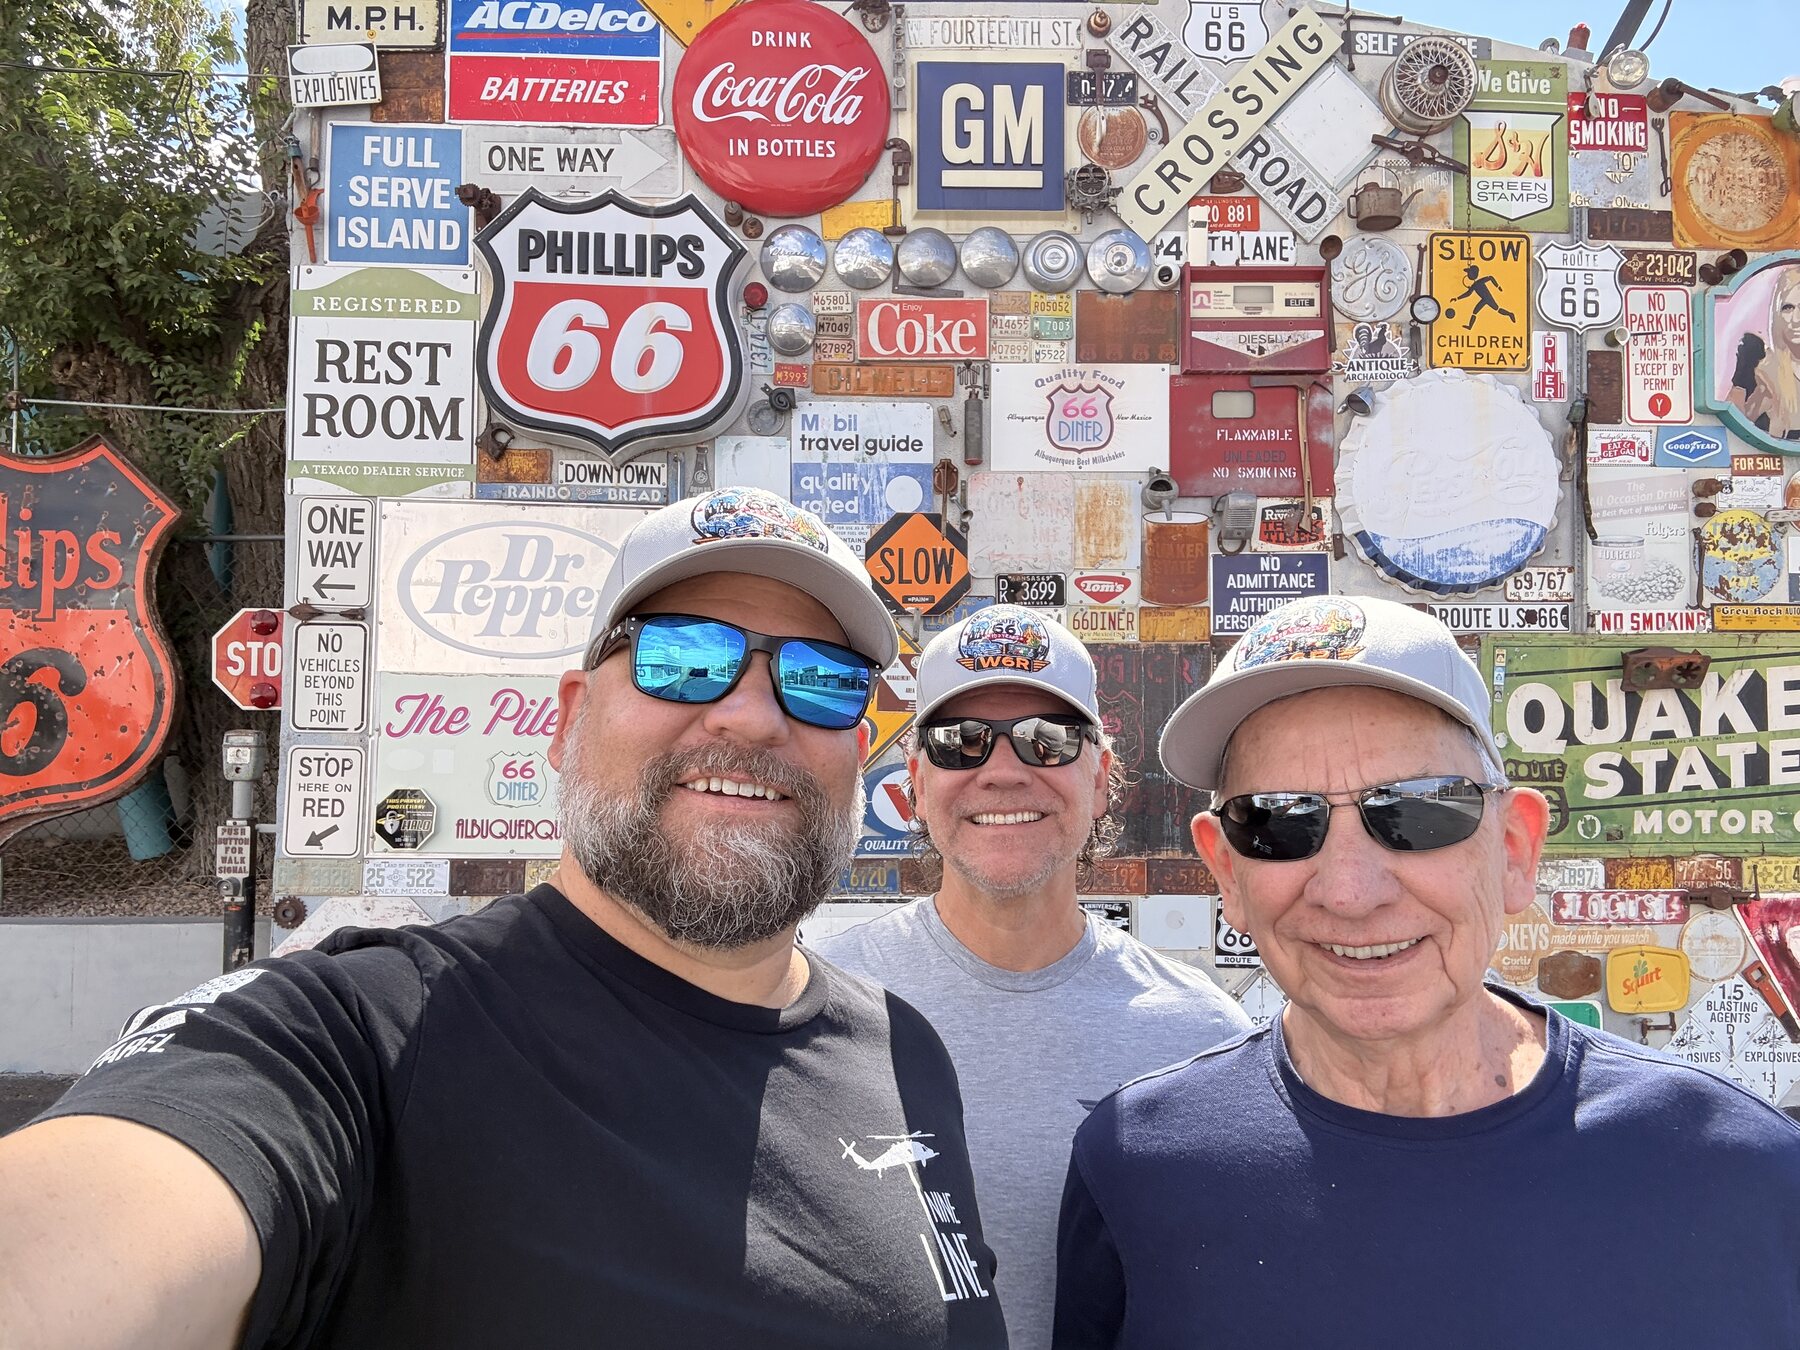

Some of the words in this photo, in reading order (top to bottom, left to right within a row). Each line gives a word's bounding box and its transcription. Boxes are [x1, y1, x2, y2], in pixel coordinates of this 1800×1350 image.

[328, 6, 424, 31] M.P.H.
[464, 1, 659, 33] ACDelco
[752, 31, 812, 48] DRINK
[933, 19, 1041, 47] FOURTEENTH
[1052, 20, 1076, 47] ST.
[1205, 21, 1245, 51] 66
[1355, 32, 1398, 55] SELF
[1120, 15, 1200, 107] RAIL
[294, 75, 377, 104] EXPLOSIVES
[480, 77, 630, 105] BATTERIES
[1507, 70, 1551, 95] Give
[692, 62, 872, 126] Coca-Cola
[1597, 97, 1619, 119] NO
[941, 83, 1044, 165] GM
[1134, 23, 1324, 216] CROSSING
[1570, 119, 1646, 147] SMOKING
[363, 136, 440, 168] FULL
[729, 138, 754, 157] IN
[758, 138, 836, 158] BOTTLES
[488, 145, 544, 172] ONE
[557, 147, 615, 173] WAY
[1238, 133, 1328, 224] ROAD
[1477, 180, 1547, 192] GREEN
[349, 176, 452, 210] SERVE
[1476, 192, 1549, 204] STAMPS
[1228, 205, 1252, 222] 881
[337, 216, 461, 251] ISLAND
[518, 228, 706, 280] PHILLIPS
[1240, 236, 1290, 261] LANE
[1439, 239, 1521, 261] SLOW
[1562, 253, 1598, 267] ROUTE
[312, 296, 462, 314] REGISTERED
[903, 302, 923, 313] Enjoy
[1561, 287, 1600, 318] 66
[1648, 293, 1666, 312] NO
[867, 302, 978, 356] Coke
[1630, 313, 1687, 332] PARKING
[527, 299, 693, 394] 66
[1238, 334, 1283, 344] DIESEL
[1437, 335, 1523, 349] CHILDREN
[1633, 334, 1639, 347] 8
[1672, 334, 1685, 347] PM
[314, 339, 451, 386] REST
[1442, 352, 1464, 365] AT
[1474, 352, 1520, 366] PLAY
[1639, 348, 1678, 361] MON-FRI
[1346, 359, 1408, 373] ANTIQUE
[1544, 338, 1556, 398] DINER
[1634, 363, 1667, 376] EXCEPT
[1672, 363, 1684, 376] BY
[776, 371, 808, 382] M3993
[1034, 368, 1087, 389] Quality
[1093, 369, 1126, 390] Food
[1346, 372, 1409, 381] ARCHAEOLOGY
[1643, 379, 1676, 391] PERMIT
[301, 393, 465, 441] ROOM
[1062, 396, 1098, 418] 66
[1058, 420, 1103, 442] DINER
[1216, 430, 1293, 441] FLAMMABLE
[800, 434, 859, 452] travel
[864, 434, 924, 456] guide
[1602, 450, 1618, 458] GET
[1620, 448, 1635, 456] GAS
[1668, 442, 1718, 453] GOODYEAR
[1076, 456, 1091, 466] Best
[1092, 451, 1126, 465] Milkshakes
[1223, 450, 1287, 463] UNLEADED
[1734, 457, 1754, 471] FOR
[1756, 457, 1781, 471] SALE
[301, 464, 310, 474] A
[313, 464, 359, 475] TEXACO
[363, 465, 411, 477] DEALER
[415, 467, 465, 478] SERVICE
[564, 463, 661, 485] DOWNTOWN
[1212, 466, 1230, 478] NO
[1238, 466, 1297, 479] SMOKING
[507, 485, 571, 499] RAINBO
[608, 487, 661, 502] BREAD
[800, 472, 871, 495] quality
[1627, 482, 1646, 493] The
[800, 497, 859, 514] rated
[1607, 492, 1653, 505] Occasion
[1656, 487, 1686, 501] Drink
[307, 506, 365, 535] ONE
[1602, 509, 1617, 517] Best
[1620, 507, 1634, 515] Part
[1635, 506, 1642, 514] of
[1644, 521, 1687, 539] Folgers
[308, 539, 363, 569] WAY
[491, 533, 585, 583] Dr
[1260, 556, 1281, 572] NO
[879, 547, 955, 586] SLOW
[1021, 581, 1057, 601] 3699
[1081, 580, 1124, 593] Tom's
[1226, 573, 1316, 589] ADMITTANCE
[1072, 611, 1135, 631] 66DINER
[1439, 607, 1492, 629] ROUTE
[1538, 607, 1558, 629] 66
[1721, 606, 1749, 616] Grey
[1753, 606, 1783, 615] Rock
[1601, 612, 1623, 631] NO
[1631, 611, 1707, 632] SMOKING
[317, 633, 343, 653] NO
[299, 658, 360, 673] VEHICLES
[979, 656, 1030, 670] W6R
[304, 675, 355, 689] BEYOND
[315, 692, 343, 706] THIS
[0, 647, 87, 777] 6
[309, 710, 346, 723] POINT
[385, 692, 472, 739] The
[1506, 666, 1800, 755] QUAKE
[299, 756, 353, 778] STOP
[502, 759, 536, 780] 66
[1506, 762, 1563, 778] ROUTE
[1583, 739, 1800, 800] STATE
[298, 782, 329, 792] HERE
[334, 783, 352, 792] ON
[496, 781, 539, 801] DINER
[302, 797, 345, 818] RED
[1633, 808, 1774, 836] MOTOR
[217, 837, 249, 845] BUTTON
[221, 828, 246, 837] PUSH
[224, 846, 244, 855] FOR
[864, 839, 911, 851] QUALITY
[218, 865, 249, 874] SIGNAL
[221, 855, 246, 864] WALK
[366, 868, 386, 888] 25
[406, 868, 436, 888] 522
[1571, 893, 1670, 921] LOCUST
[1223, 932, 1253, 948] 66
[1509, 923, 1550, 951] KEYS
[1551, 933, 1577, 945] made
[1577, 932, 1602, 945] while
[1603, 934, 1621, 948] you
[1621, 932, 1650, 944] watch
[1224, 956, 1253, 964] ROUTE
[1502, 956, 1532, 965] Curtis
[1622, 966, 1662, 996] Squirt
[1718, 983, 1744, 1000] 1.5
[1706, 1000, 1758, 1013] BLASTING
[1710, 1012, 1751, 1023] AGENTS
[1726, 1024, 1735, 1035] D
[1745, 1051, 1800, 1063] EXPLOSIVES
[924, 1191, 961, 1224] NINE
[920, 1232, 990, 1302] LINE
